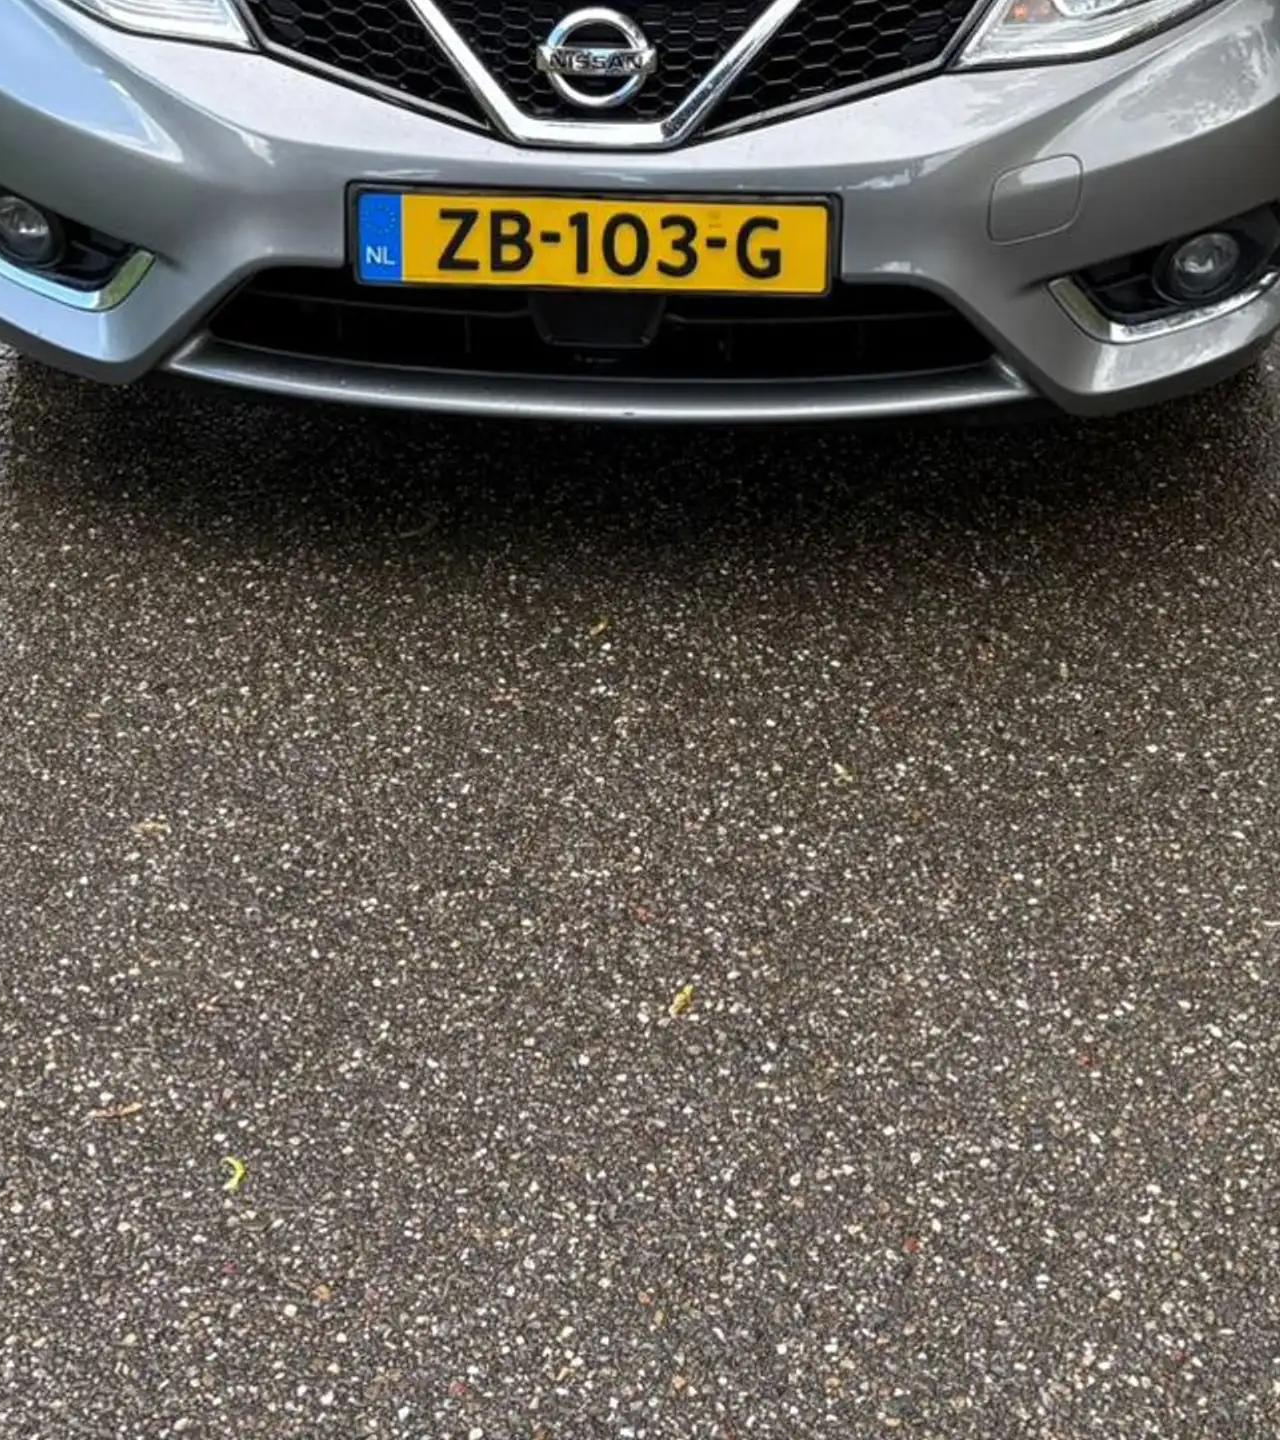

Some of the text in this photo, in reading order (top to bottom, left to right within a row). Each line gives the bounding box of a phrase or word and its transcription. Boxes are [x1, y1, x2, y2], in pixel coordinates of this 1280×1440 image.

[549, 48, 643, 70] NISSAN
[437, 208, 782, 280] ZB-103-G
[366, 245, 396, 266] NL
